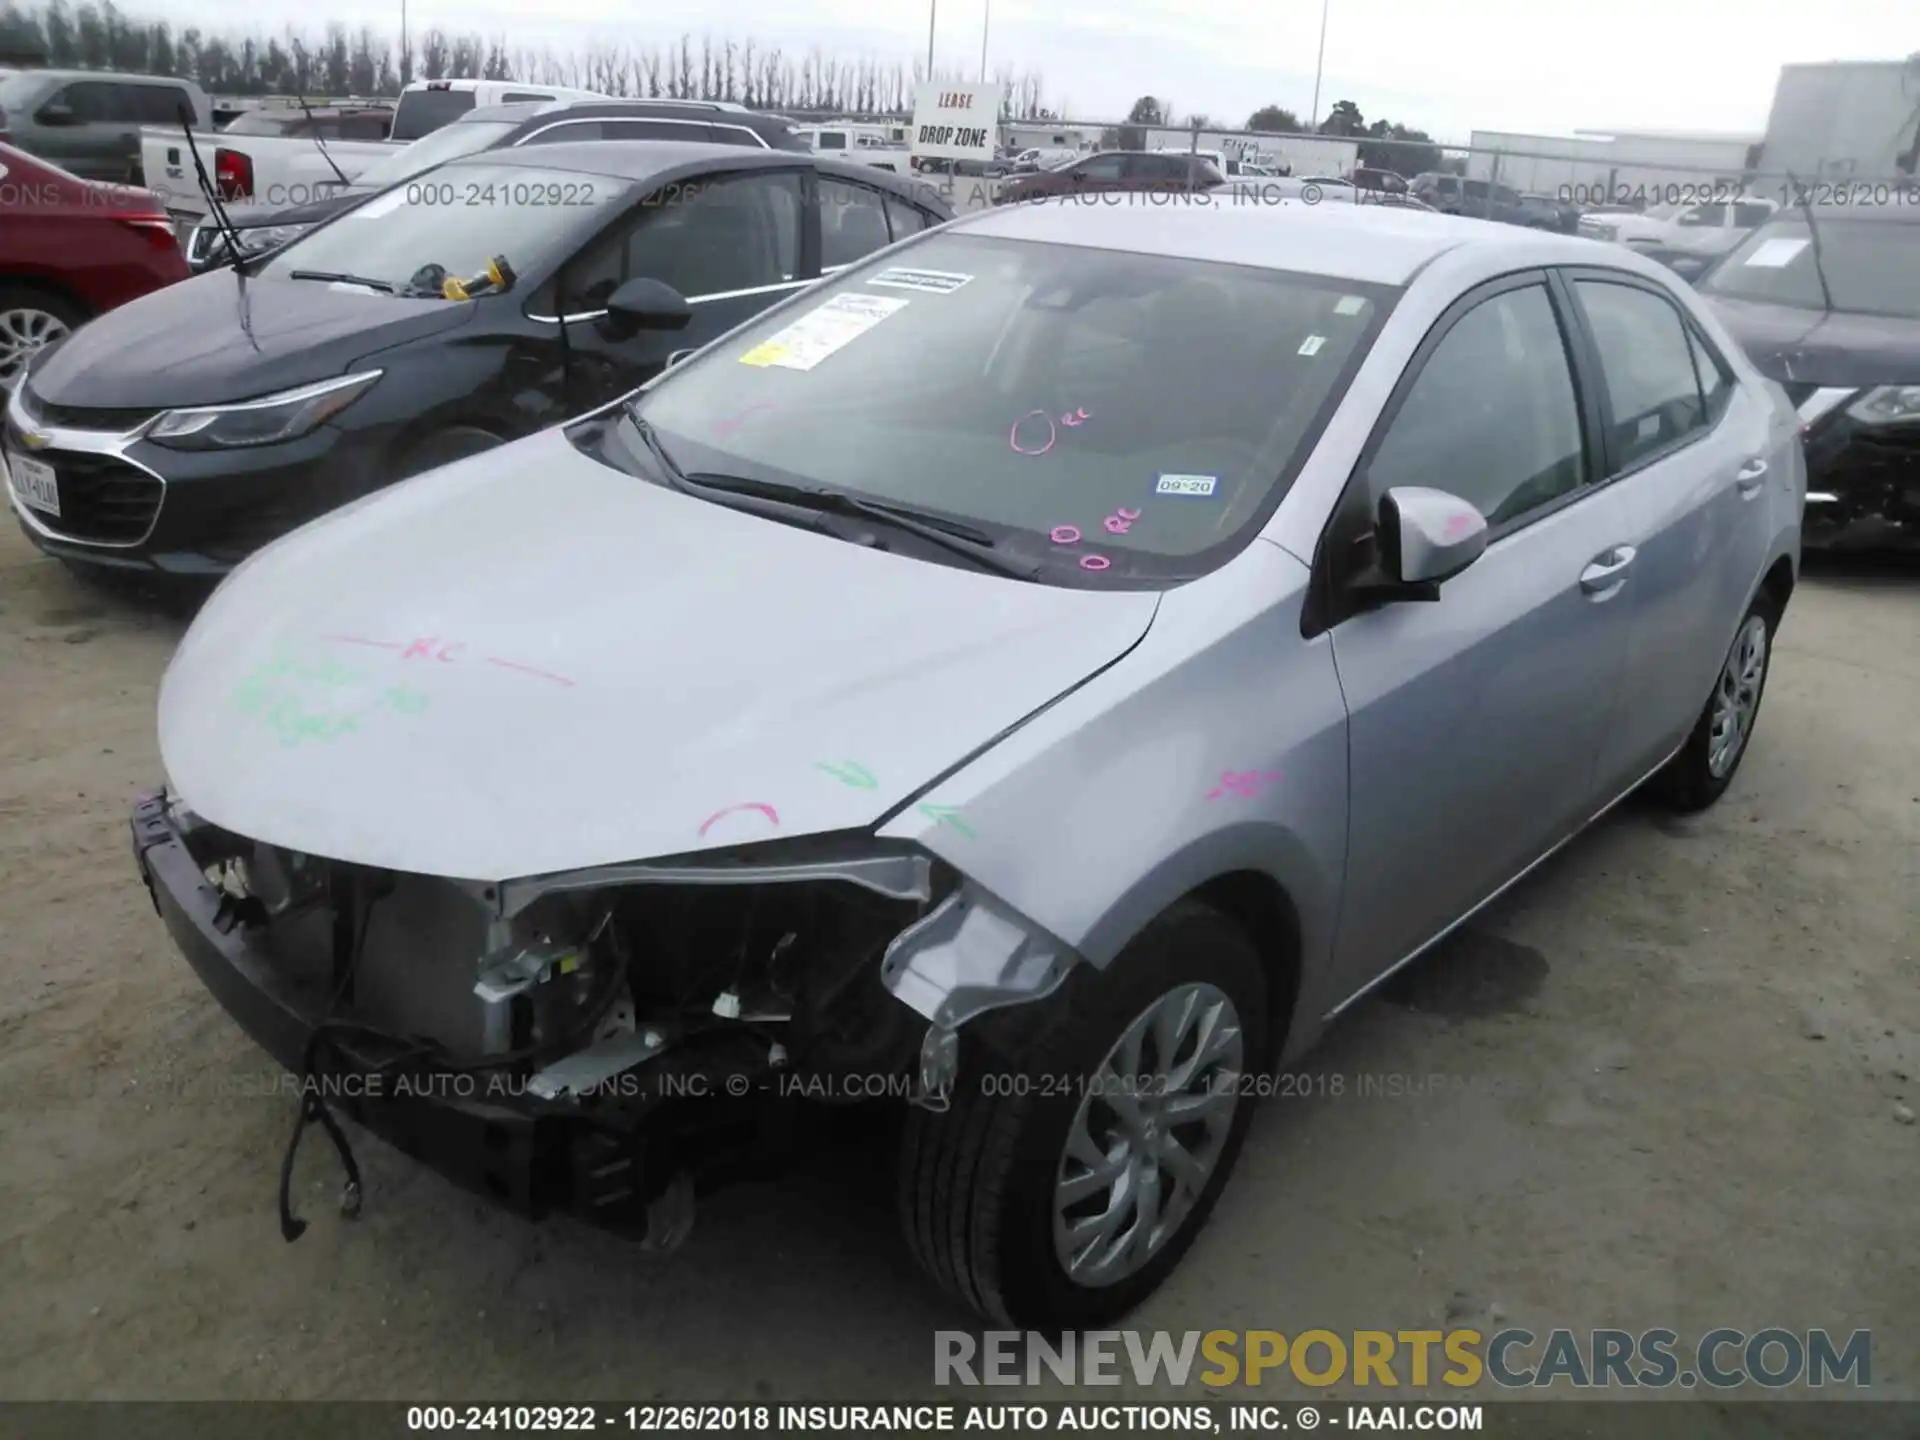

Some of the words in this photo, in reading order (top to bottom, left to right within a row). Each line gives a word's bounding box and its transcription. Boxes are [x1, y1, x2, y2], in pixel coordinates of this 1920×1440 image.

[937, 92, 974, 109] LEASE
[918, 124, 954, 145] DROP
[953, 127, 988, 148] ZONE
